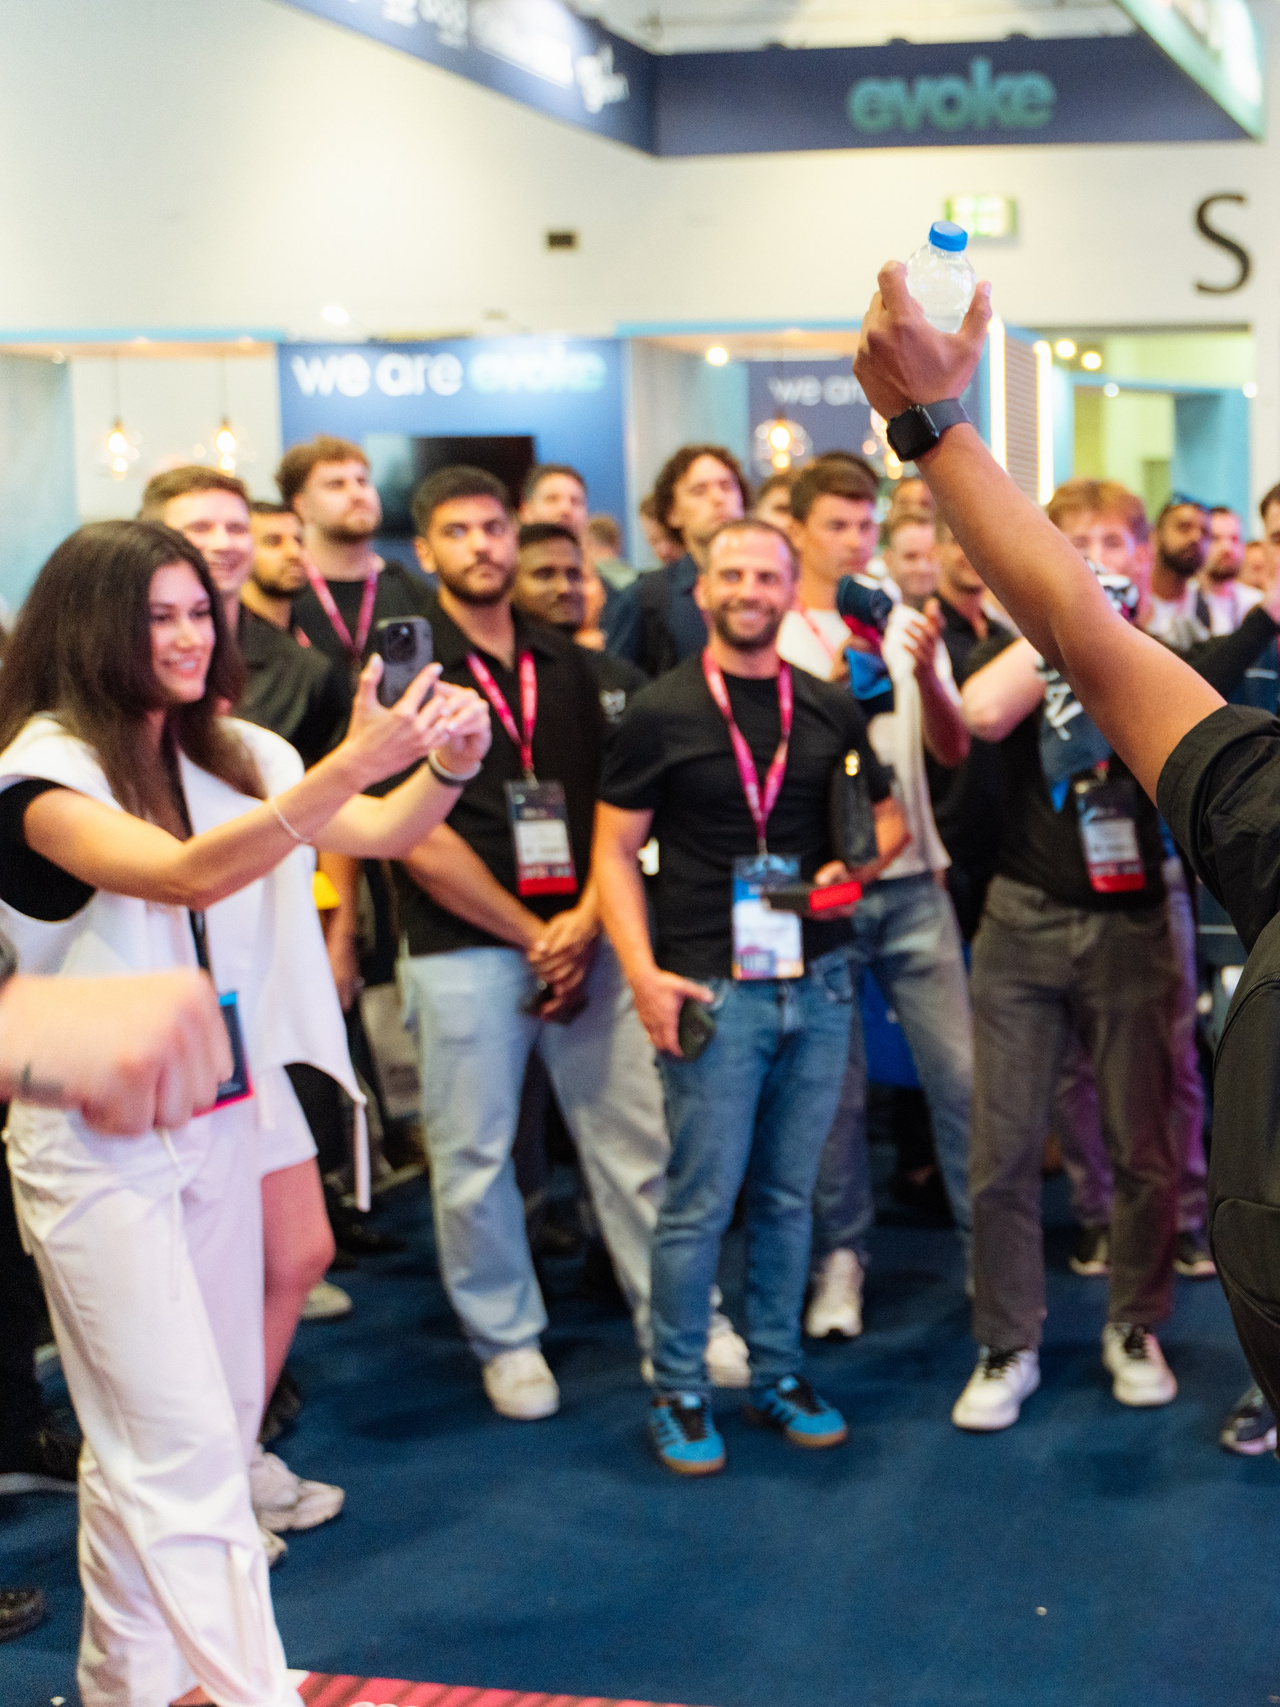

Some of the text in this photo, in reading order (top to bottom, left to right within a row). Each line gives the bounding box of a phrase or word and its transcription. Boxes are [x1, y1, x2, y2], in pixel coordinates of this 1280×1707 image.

[849, 57, 1056, 134] evoke
[291, 353, 371, 397] we
[376, 353, 464, 396] are
[766, 375, 871, 407] we ar
